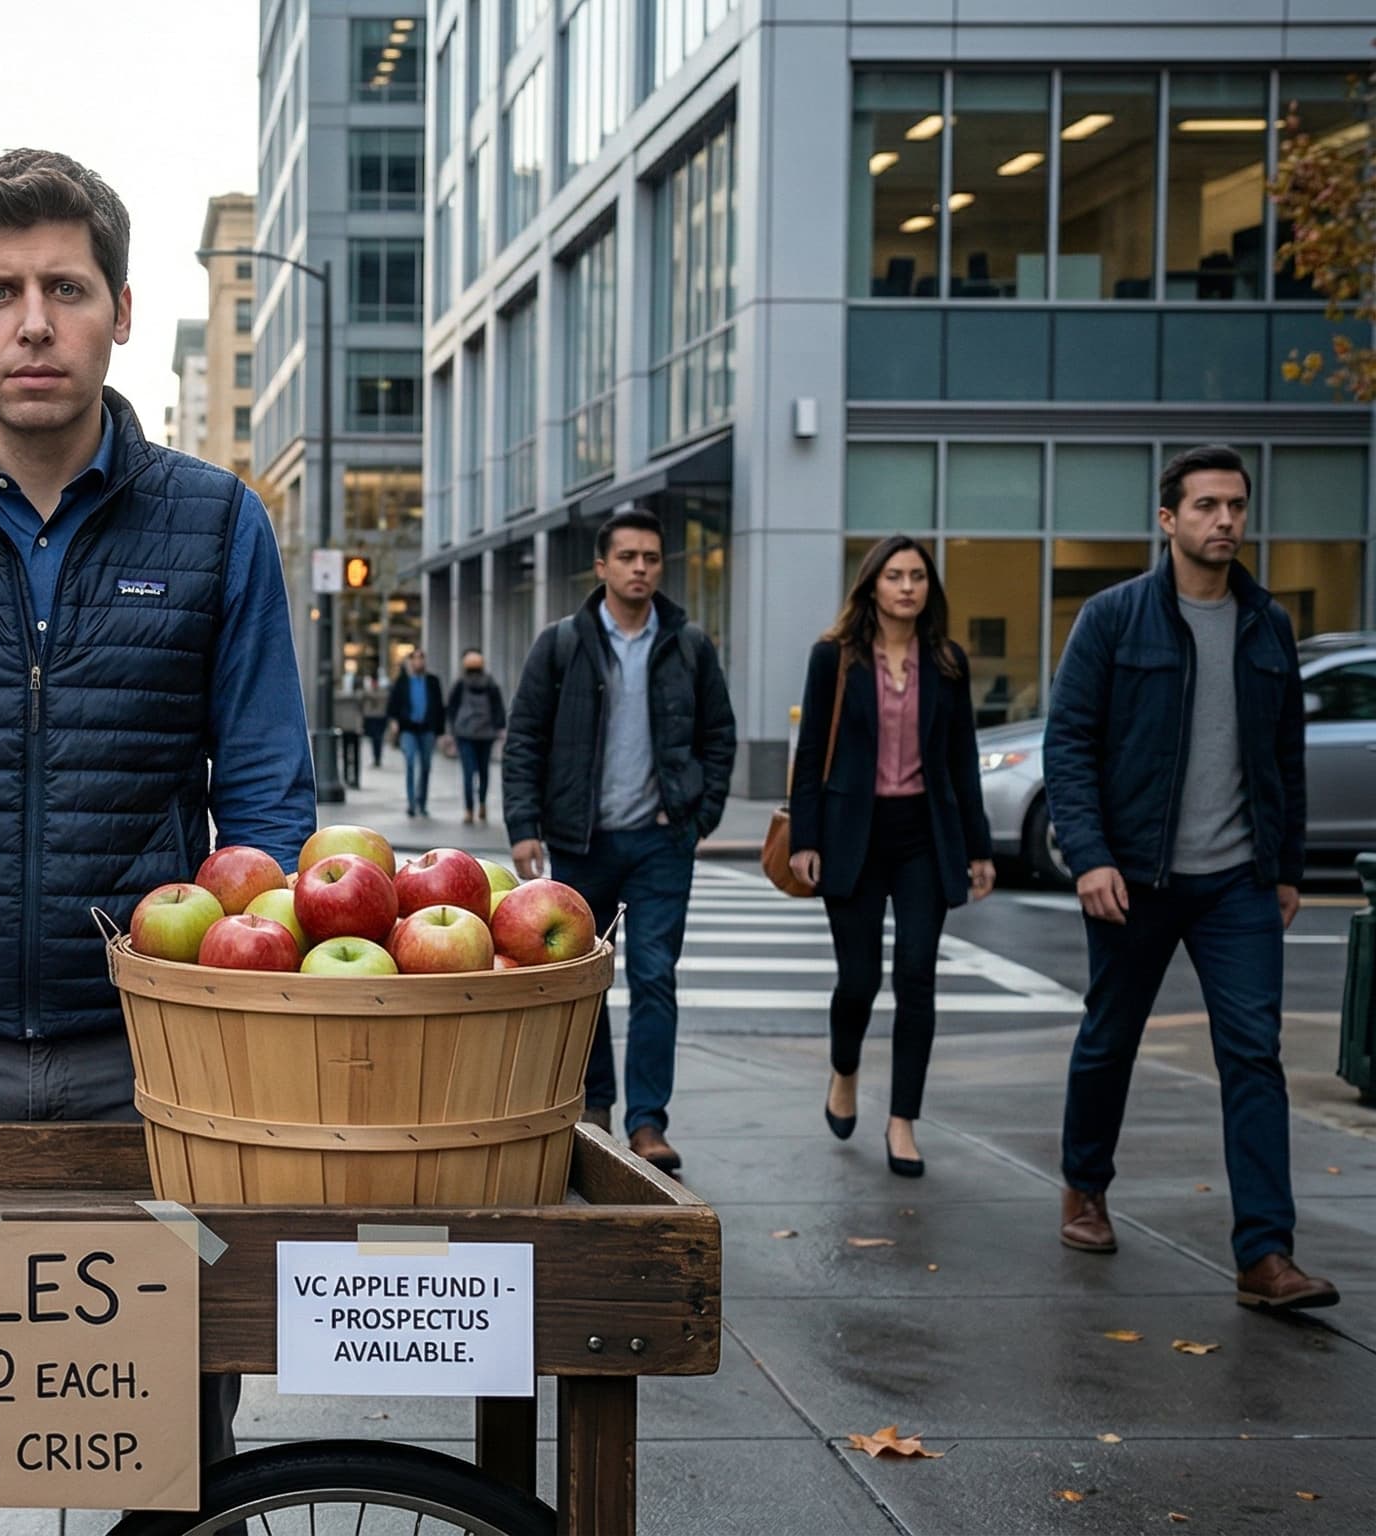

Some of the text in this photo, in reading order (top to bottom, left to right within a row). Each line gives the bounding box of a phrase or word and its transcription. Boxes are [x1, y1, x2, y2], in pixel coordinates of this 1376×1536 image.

[293, 1275, 328, 1297] VC
[333, 1275, 410, 1297] APPLE
[417, 1276, 486, 1298] FUND
[493, 1277, 499, 1298] I
[331, 1308, 490, 1331] PROSPECTUS
[334, 1340, 475, 1363] AVAILABLE.
[36, 1361, 149, 1399] EACH.
[16, 1432, 143, 1472] CRISP.
